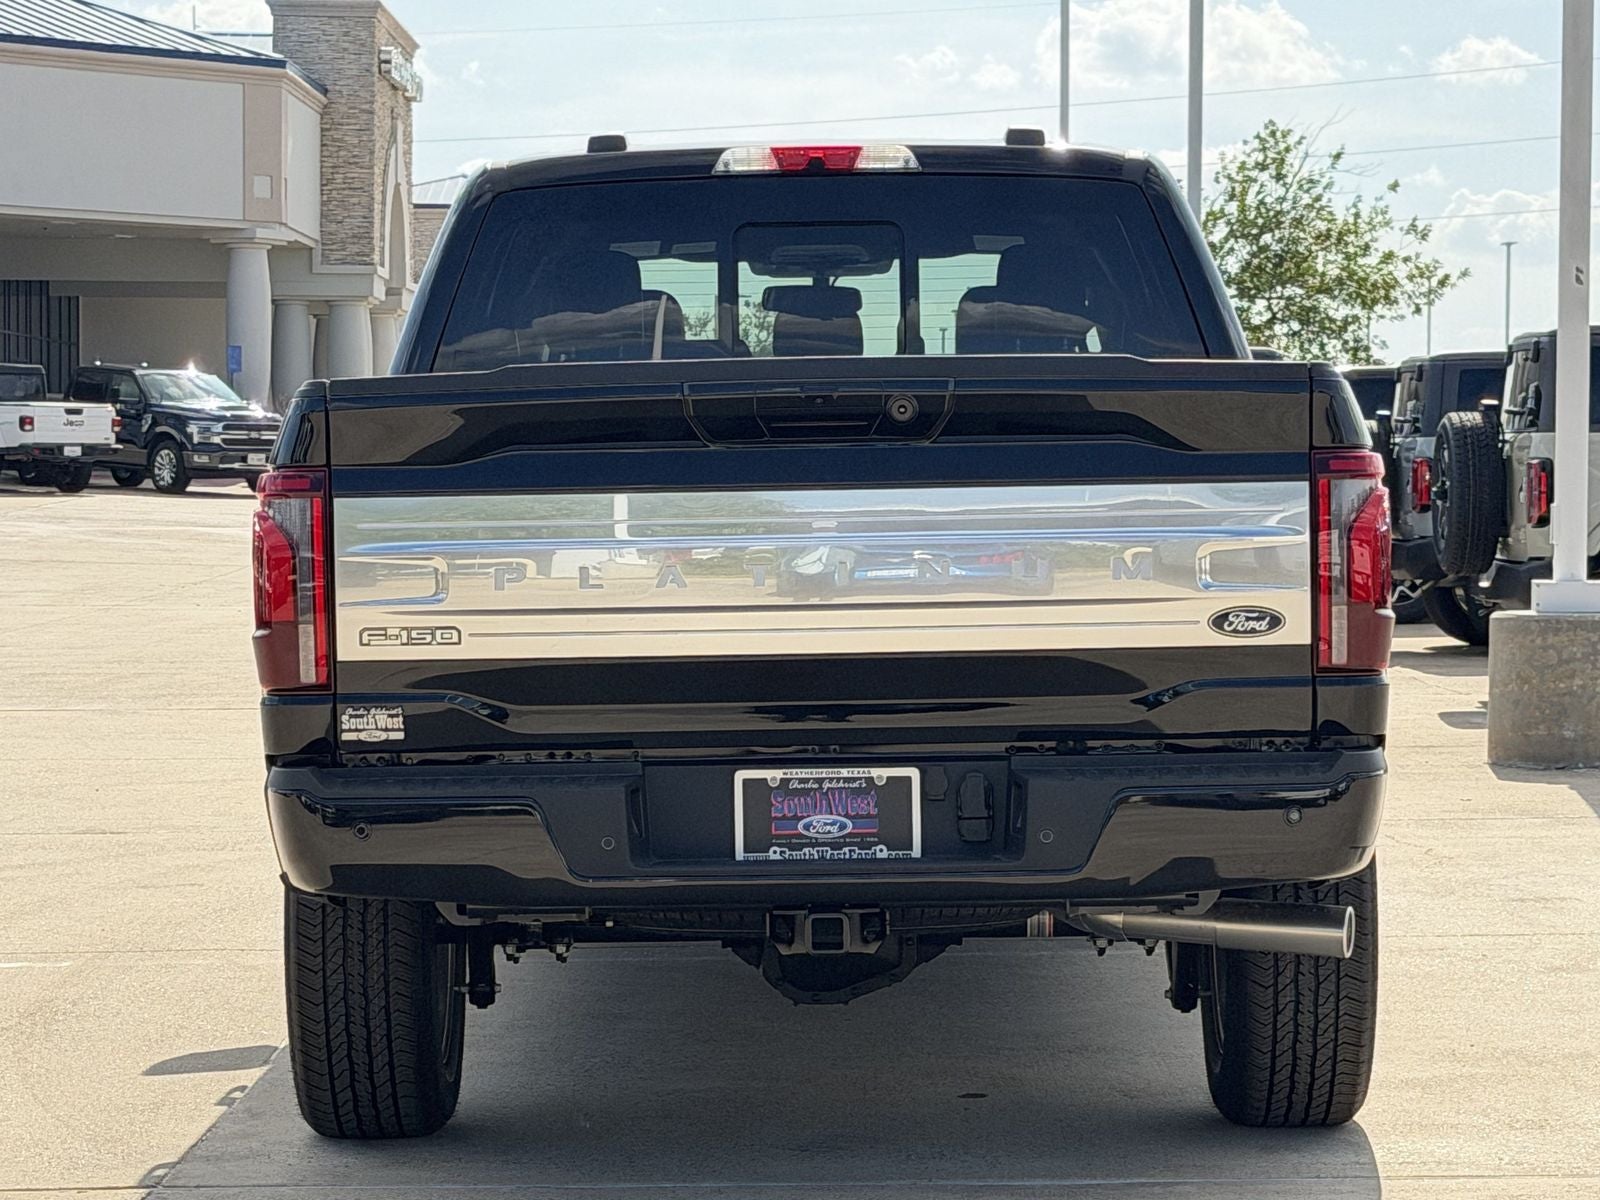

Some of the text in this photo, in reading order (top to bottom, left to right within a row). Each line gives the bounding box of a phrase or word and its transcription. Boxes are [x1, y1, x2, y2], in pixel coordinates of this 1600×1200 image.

[494, 556, 1153, 591] PLATINUM
[1223, 611, 1271, 631] Ford
[359, 626, 462, 646] F-150
[788, 779, 820, 789] Charlie
[809, 818, 840, 833] Ford
